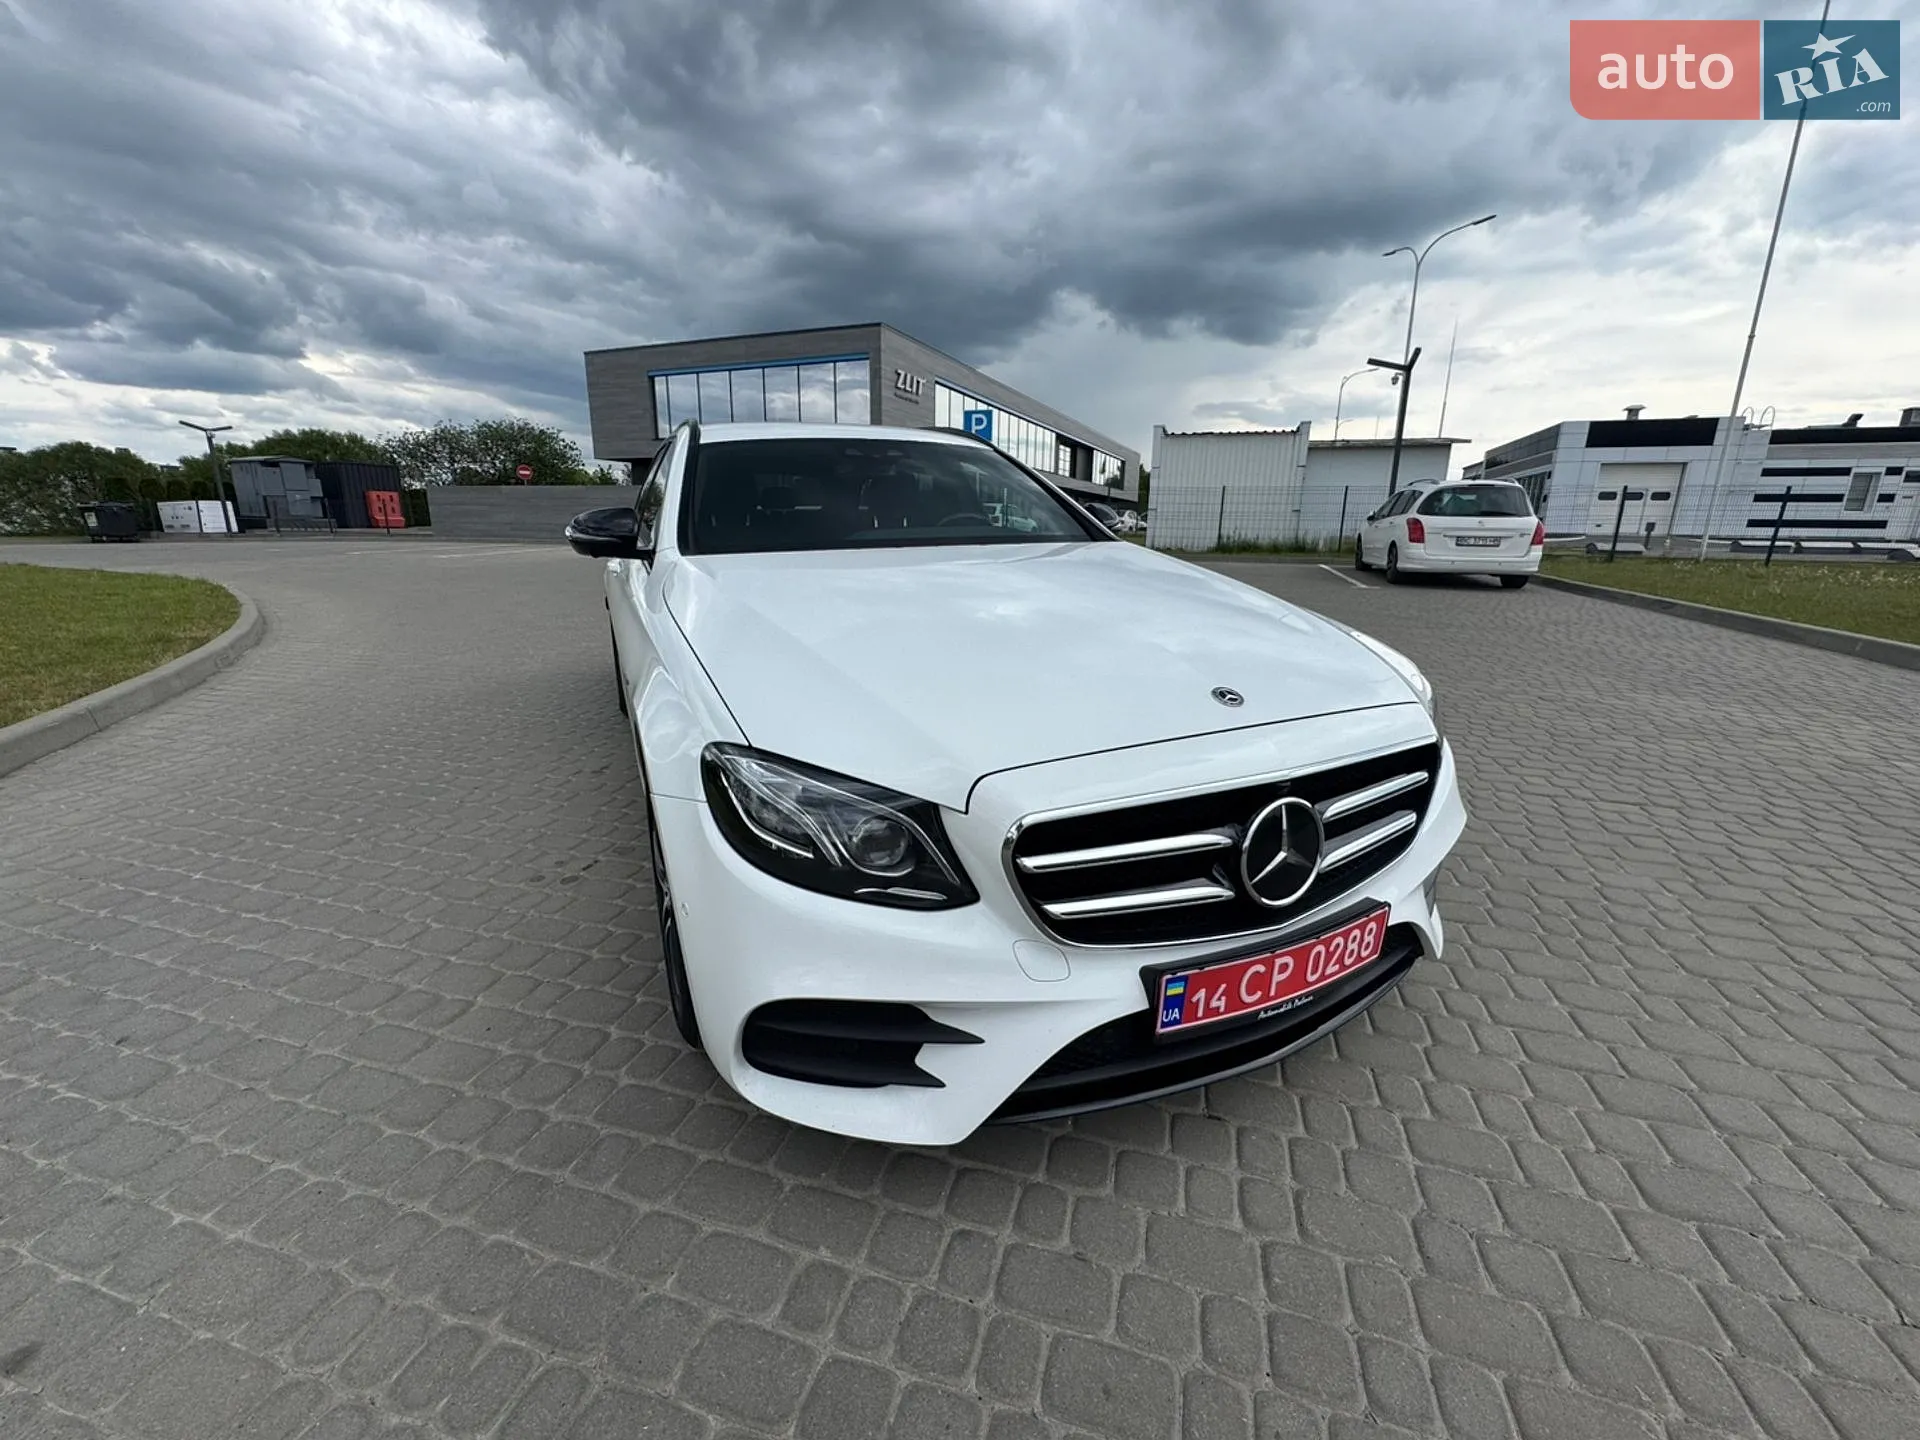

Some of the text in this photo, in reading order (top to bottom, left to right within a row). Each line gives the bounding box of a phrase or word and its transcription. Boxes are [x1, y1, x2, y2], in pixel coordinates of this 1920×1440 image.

[895, 369, 927, 396] ZLIT
[971, 413, 988, 434] P
[1191, 921, 1378, 1018] 14 CP 0288
[1162, 1007, 1181, 1022] UA
